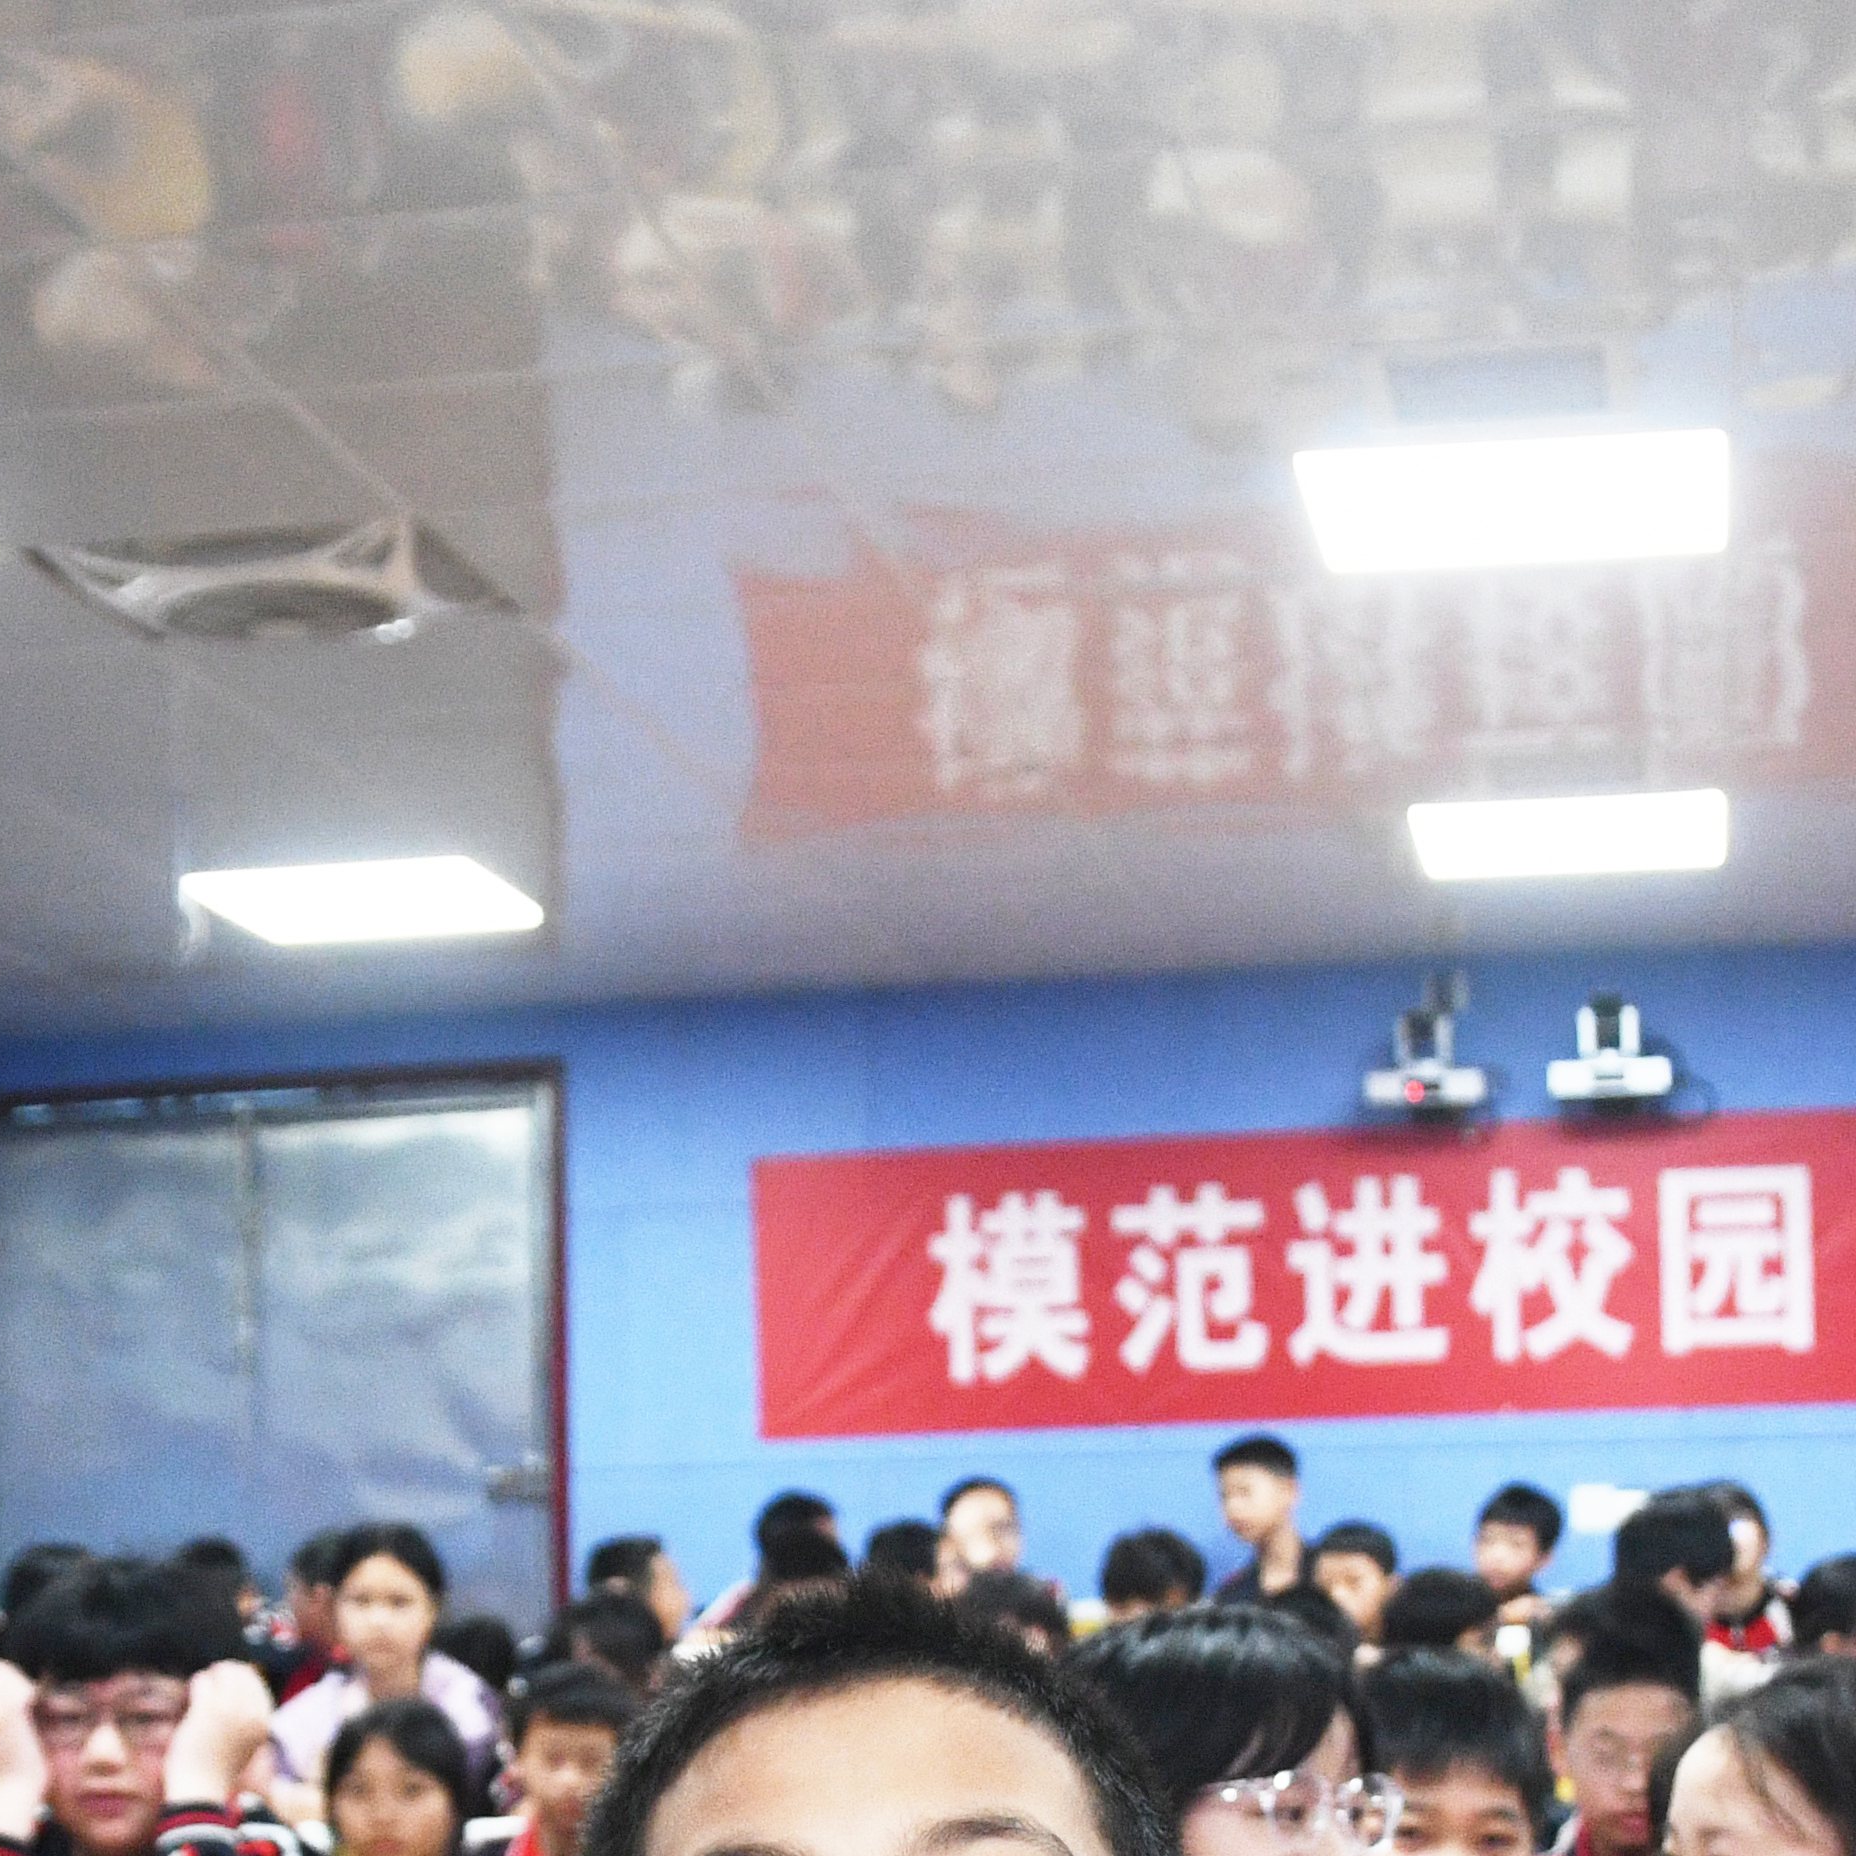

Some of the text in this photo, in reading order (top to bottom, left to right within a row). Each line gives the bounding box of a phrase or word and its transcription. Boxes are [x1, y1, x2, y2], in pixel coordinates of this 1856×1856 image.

[927, 1162, 1816, 1387] 模范进校园
